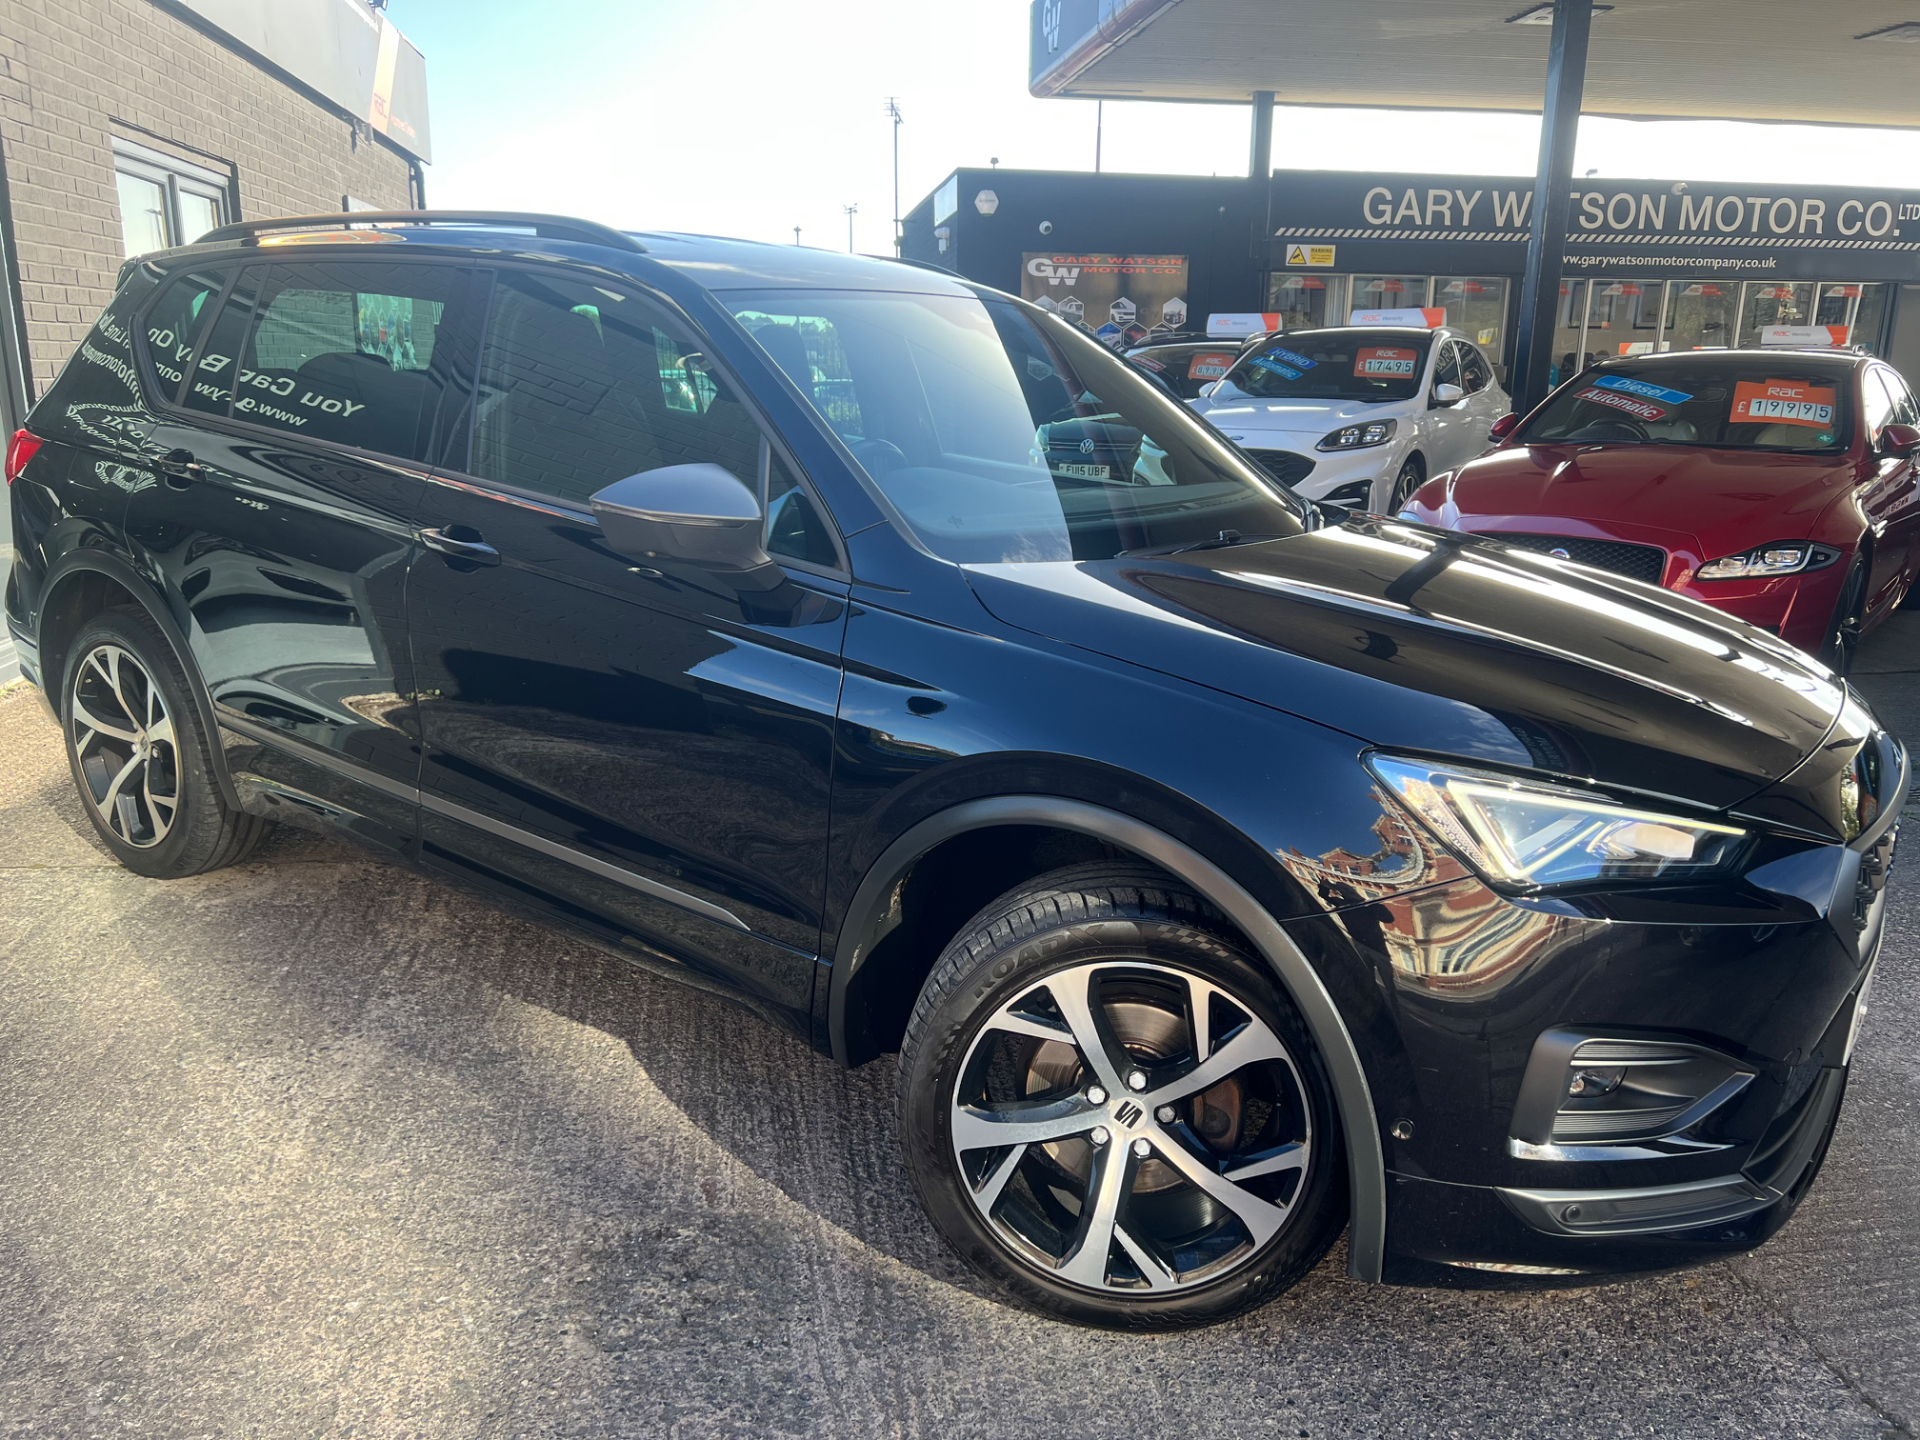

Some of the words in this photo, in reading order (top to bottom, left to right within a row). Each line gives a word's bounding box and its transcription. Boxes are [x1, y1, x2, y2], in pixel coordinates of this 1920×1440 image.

[1362, 187, 1483, 226] GARY
[1492, 190, 1667, 230] WSON
[1678, 195, 1827, 235] MOTOR
[1836, 200, 1900, 237] CO.
[1898, 203, 1920, 221] LTD
[1052, 256, 1102, 264] GARY
[1107, 257, 1183, 266] WATSON
[1562, 254, 1776, 270] ww.garywatsonmotorcompany.co.uk
[1027, 258, 1080, 286] GW
[1083, 266, 1149, 274] MOTOR
[1152, 267, 1181, 275] CO.
[1361, 314, 1382, 322] RAC
[1272, 348, 1310, 367] HYBRID
[1376, 349, 1399, 357] RAC
[1253, 357, 1297, 379] Automatic
[1613, 379, 1665, 399] Diesel
[1767, 386, 1804, 398] RAC
[1583, 388, 1658, 417] Automatic
[1087, 466, 1107, 477] UBF
[971, 923, 1105, 999] ROADX
